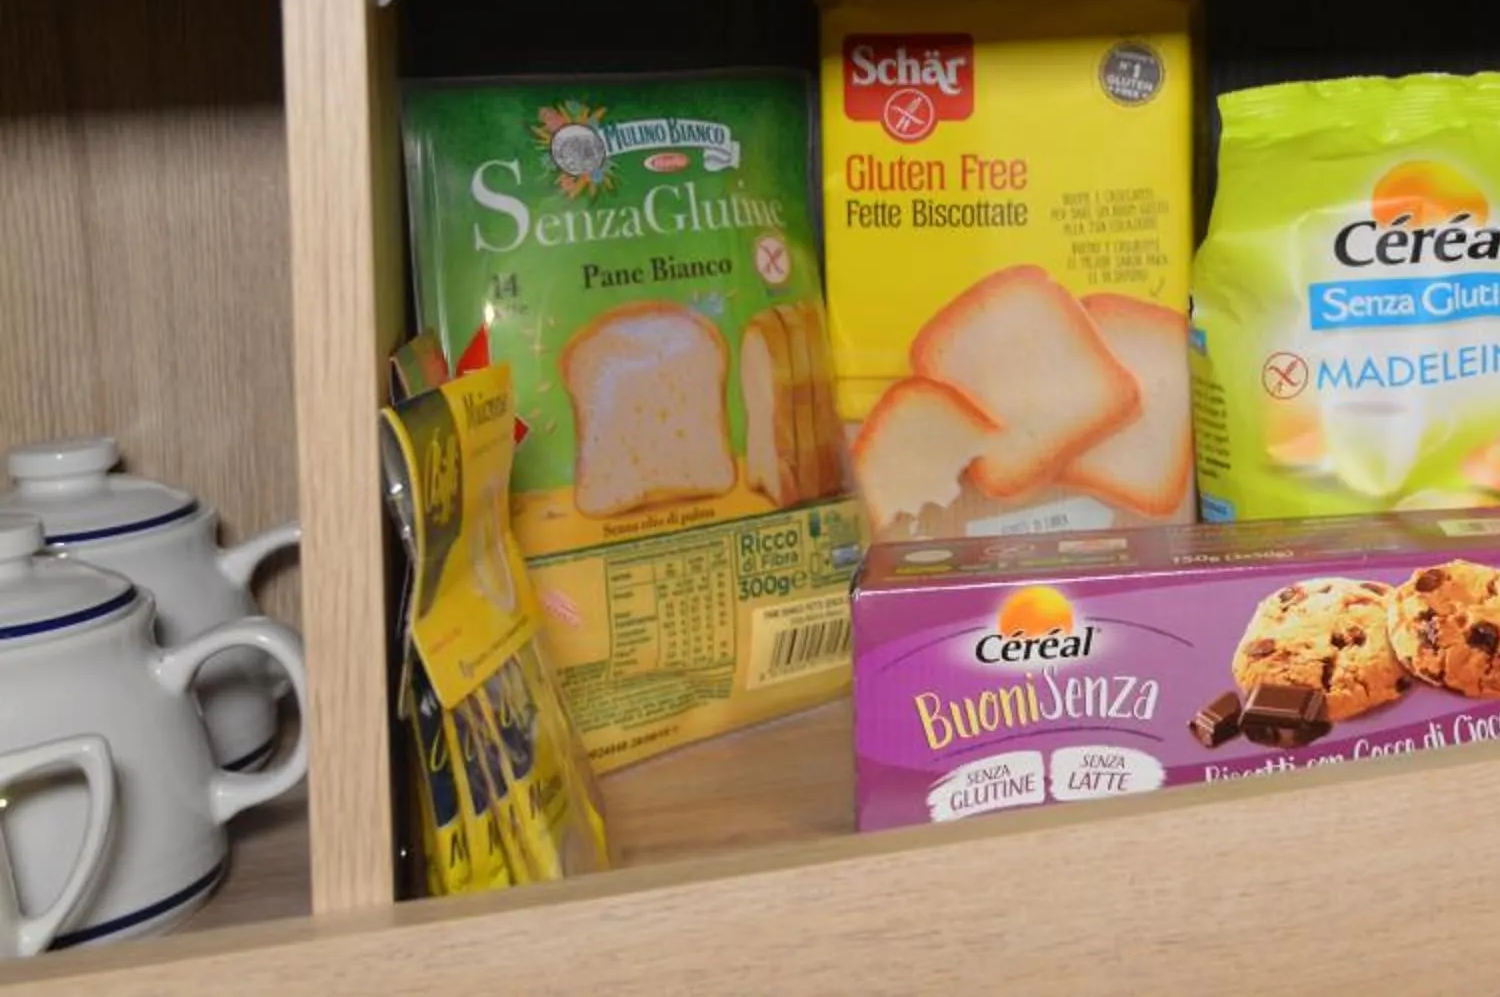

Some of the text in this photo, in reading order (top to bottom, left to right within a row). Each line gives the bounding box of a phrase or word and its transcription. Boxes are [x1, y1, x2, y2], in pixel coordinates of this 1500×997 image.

[852, 44, 967, 95] Schär
[846, 154, 1028, 191] Gluten Free
[847, 199, 1028, 228] Fette Biscottate
[583, 256, 734, 290] Pane Bianco
[1322, 287, 1415, 322] Senza
[740, 530, 798, 556] Ricco
[742, 553, 756, 573] di
[762, 551, 799, 568] Fibra
[975, 626, 1095, 664] Céréal
[967, 764, 1011, 787] SENZA
[1080, 754, 1126, 770] SENZA
[950, 773, 1036, 812] GLUTINE
[1068, 771, 1132, 791] LATTE
